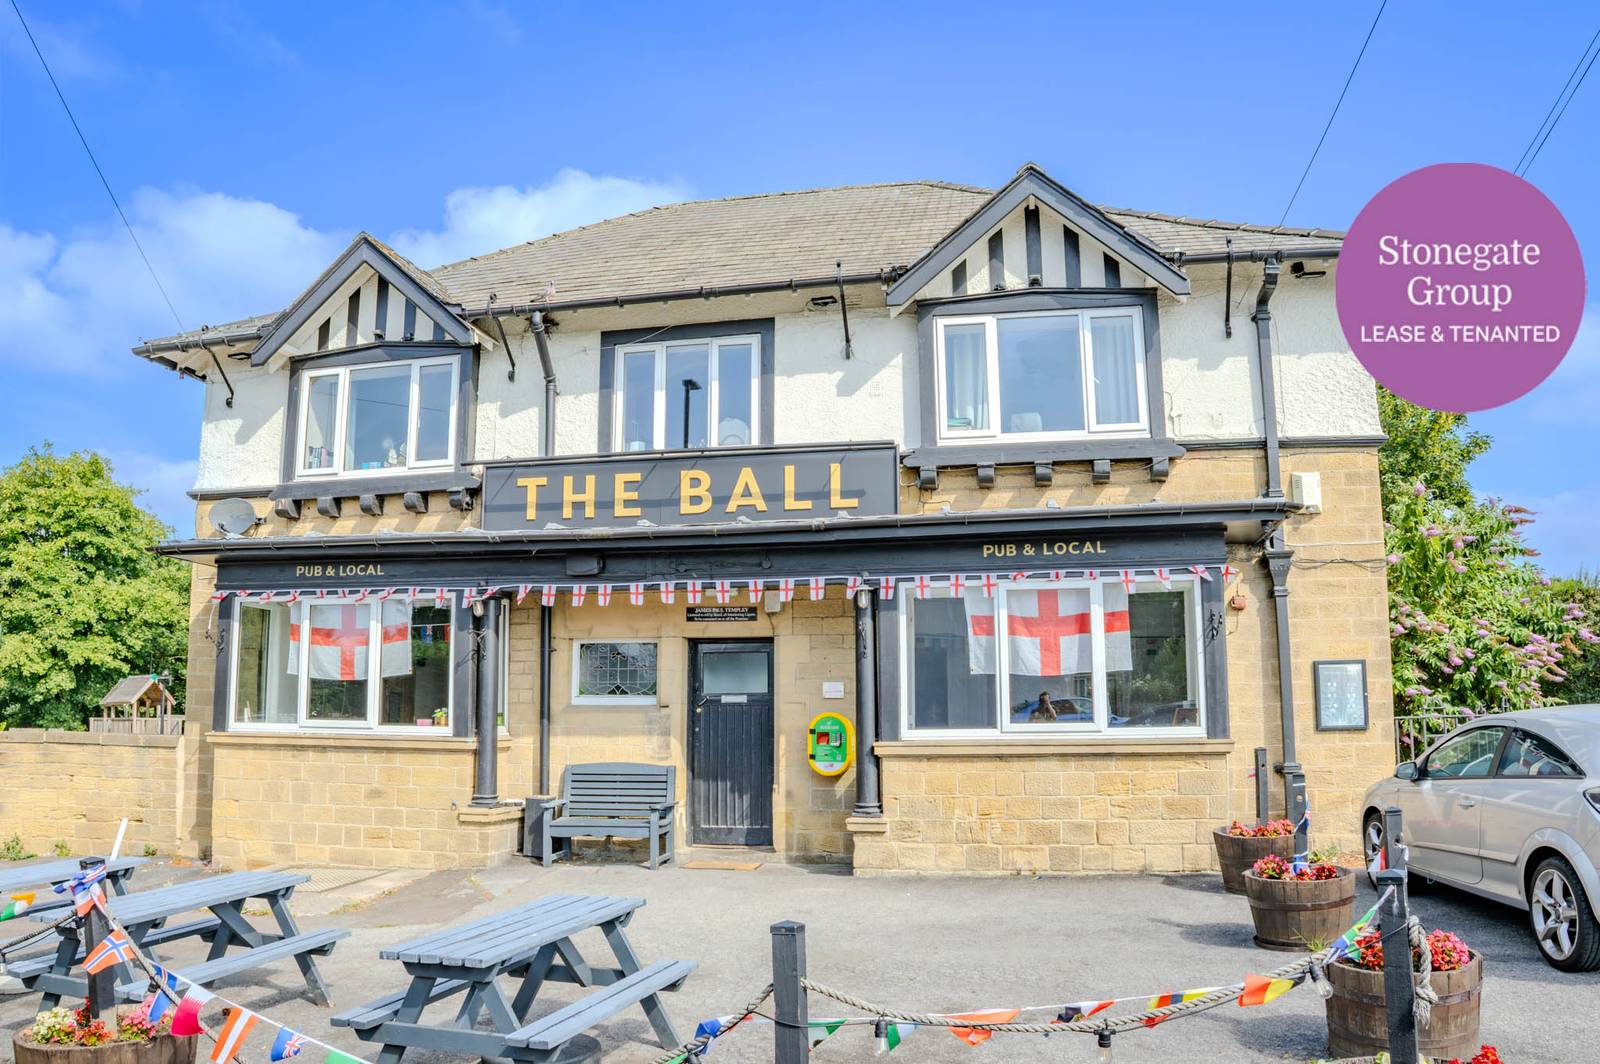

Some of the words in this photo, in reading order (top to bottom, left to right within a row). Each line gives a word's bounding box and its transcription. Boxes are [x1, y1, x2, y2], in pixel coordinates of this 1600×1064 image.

[516, 472, 642, 521] THE
[679, 463, 860, 515] BALL
[983, 544, 1017, 558] PUB
[1023, 543, 1036, 556] &
[1042, 541, 1107, 556] LOCAL
[296, 565, 322, 577] PUB
[325, 565, 336, 577] &
[339, 564, 385, 576] LOCAL
